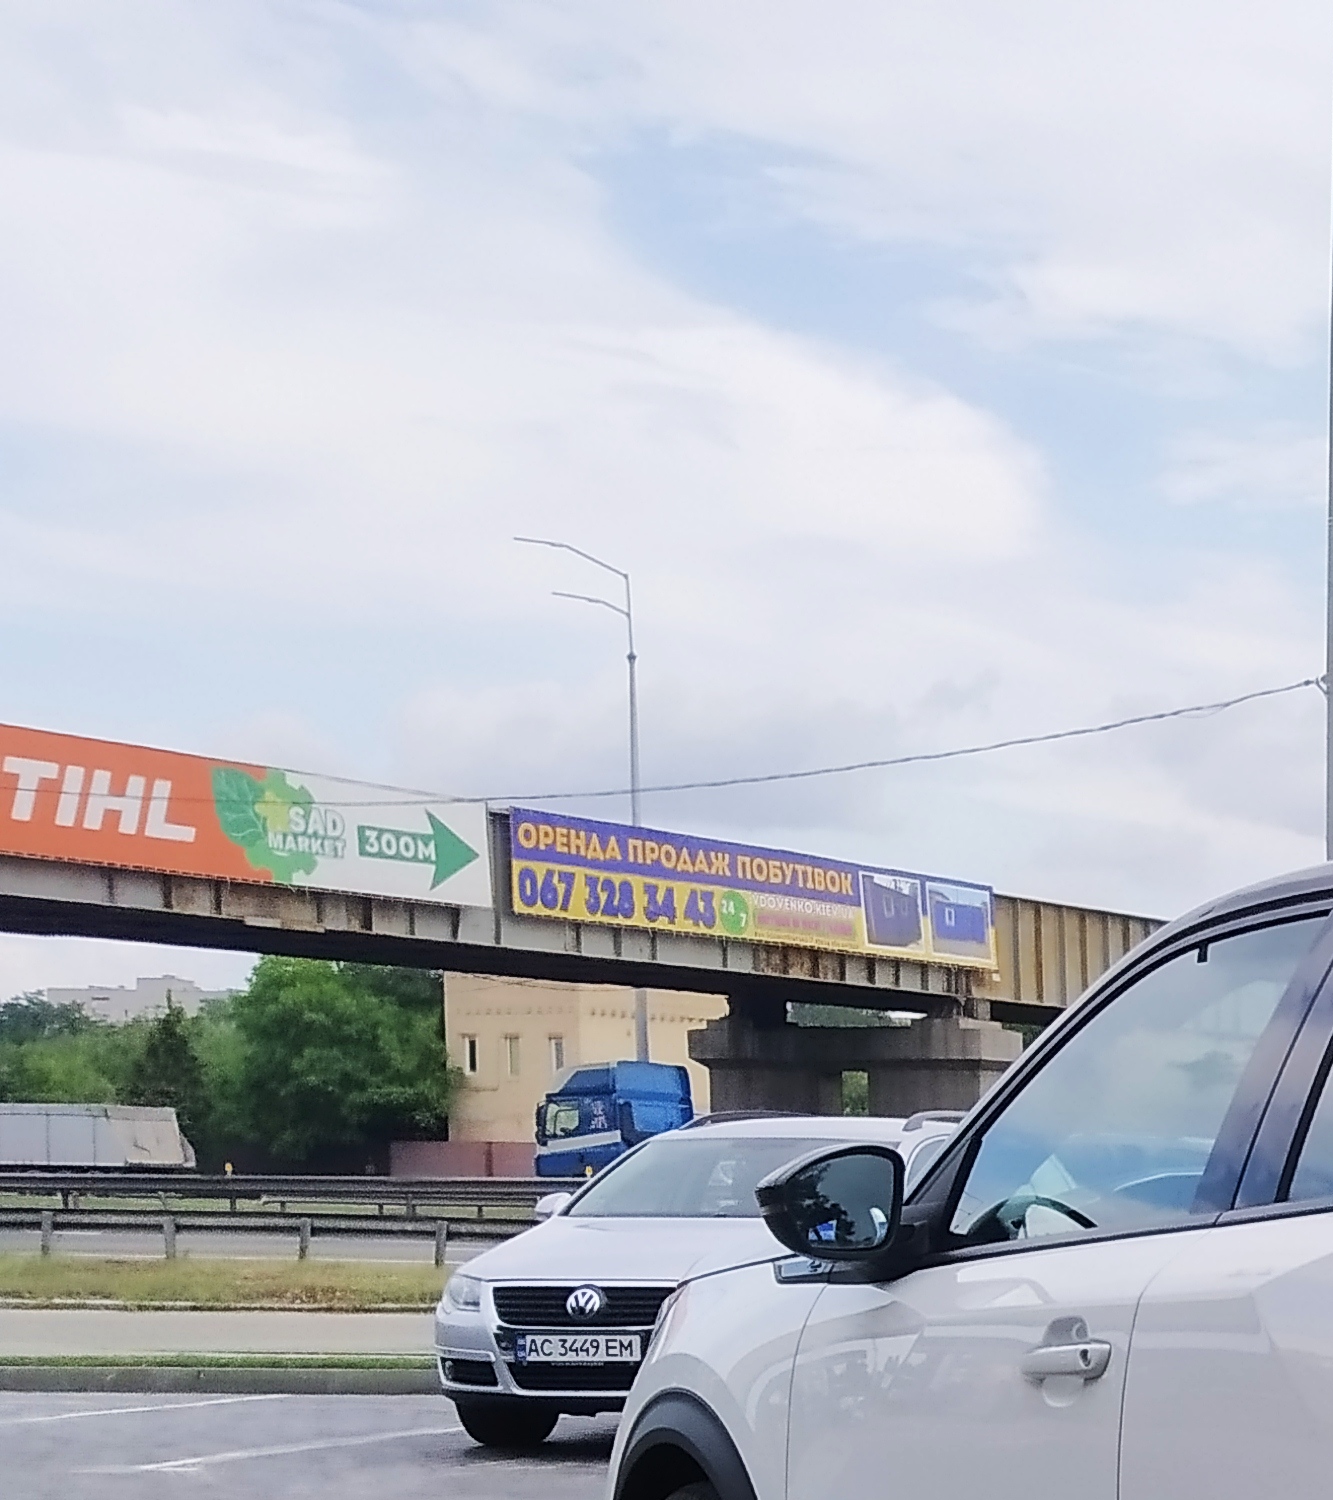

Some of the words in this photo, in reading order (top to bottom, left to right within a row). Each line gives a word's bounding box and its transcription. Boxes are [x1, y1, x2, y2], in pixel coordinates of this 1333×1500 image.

[288, 806, 346, 838] SAD
[267, 831, 347, 859] MARKET
[517, 821, 622, 862] ОРЕНДА
[627, 838, 731, 877] ПРОДАЖ
[736, 855, 854, 897] ПОБУТІВОК
[517, 866, 575, 911] 067
[583, 876, 636, 920] 328
[643, 884, 678, 926] 34
[684, 889, 717, 931] 43
[527, 1338, 553, 1357] AC
[558, 1338, 600, 1357] 3449
[605, 1338, 633, 1357] EM
